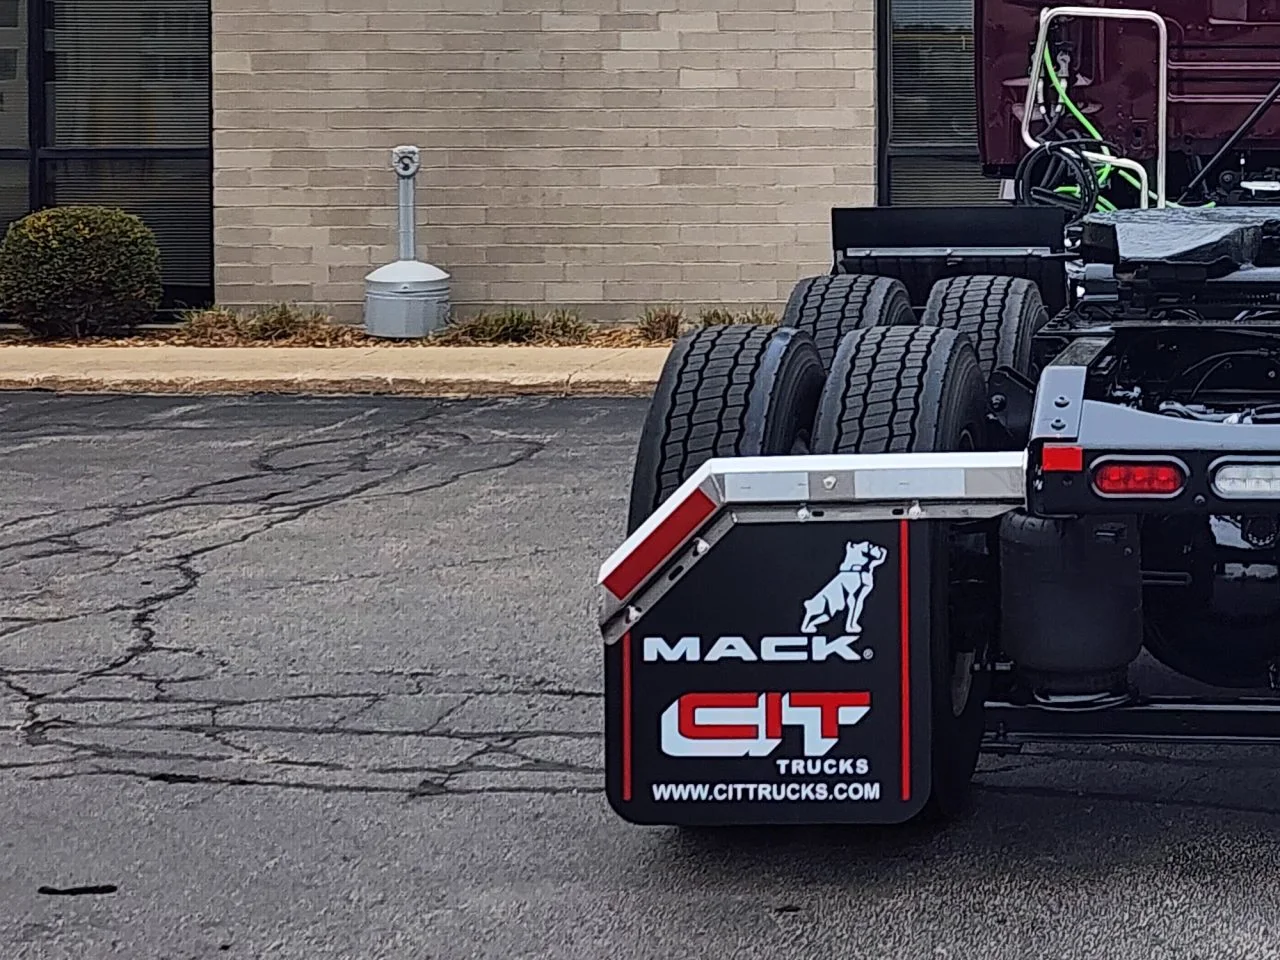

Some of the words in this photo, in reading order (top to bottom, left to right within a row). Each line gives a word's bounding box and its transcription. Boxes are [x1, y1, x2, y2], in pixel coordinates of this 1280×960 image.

[643, 635, 862, 662] MACK
[662, 691, 871, 757] CIT
[776, 759, 869, 776] TRUCKS
[652, 782, 881, 802] WWW.CITTRUCKS.COM
